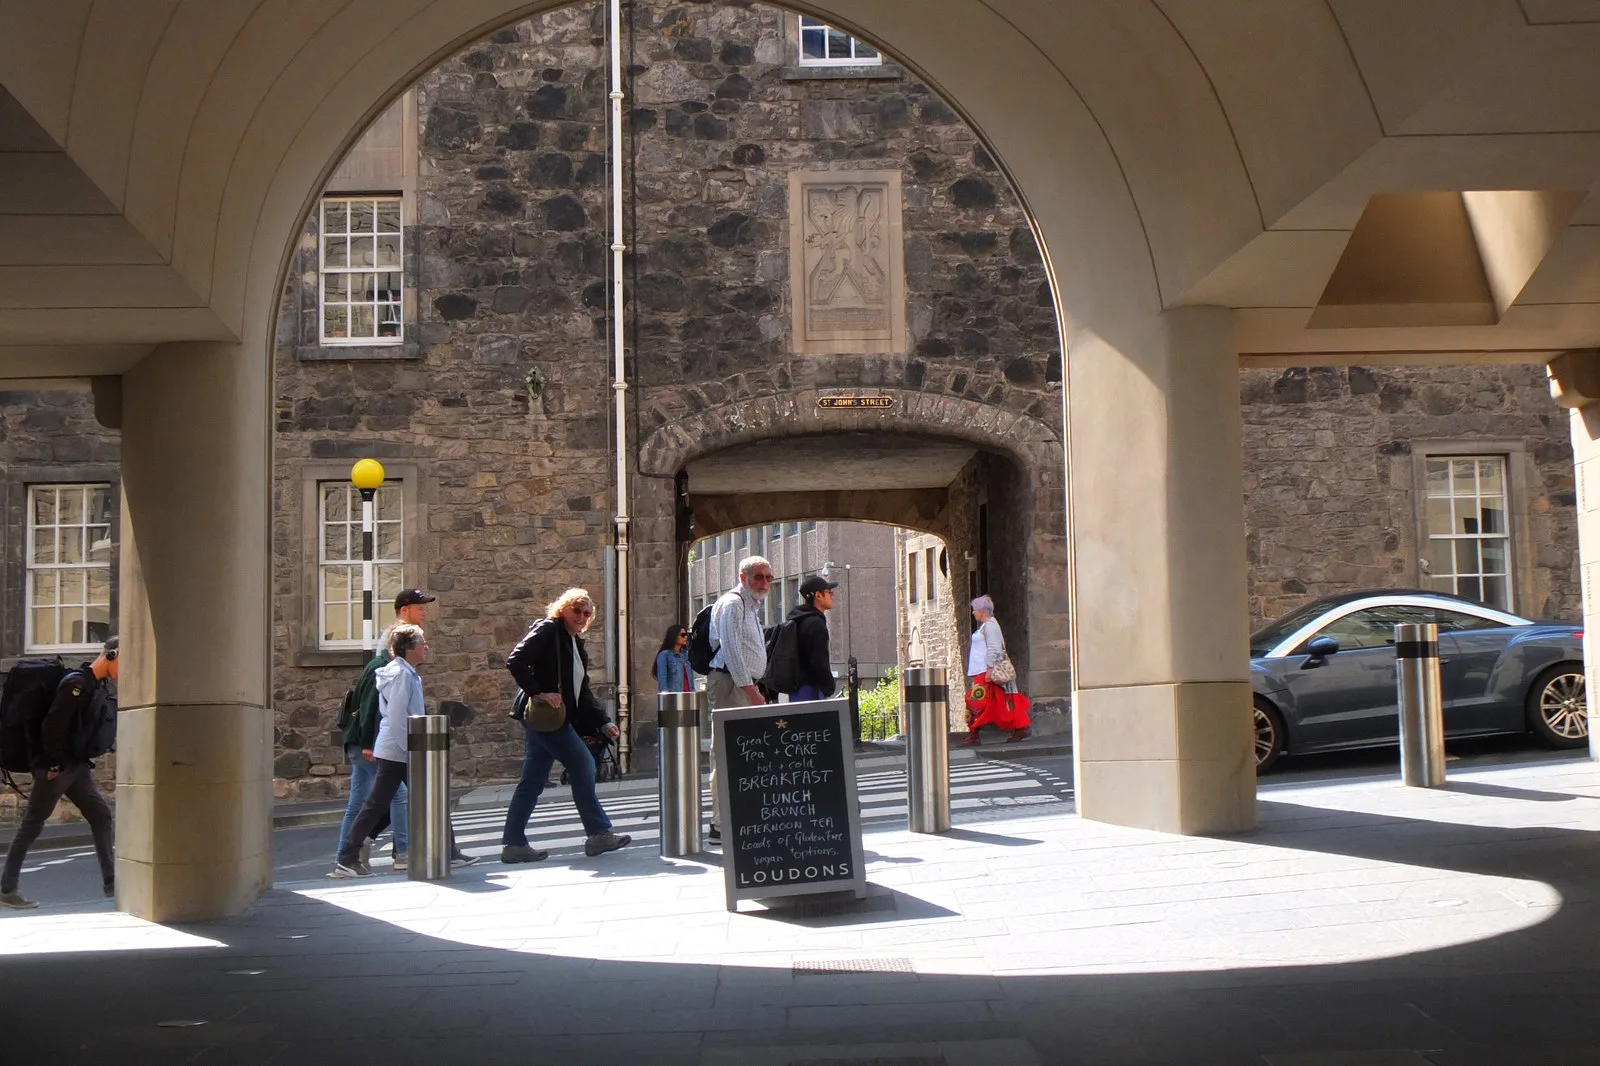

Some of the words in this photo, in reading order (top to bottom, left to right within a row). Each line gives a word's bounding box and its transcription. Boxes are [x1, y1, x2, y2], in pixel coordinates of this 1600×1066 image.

[737, 730, 773, 752] Great
[780, 729, 831, 745] COFFEE
[740, 750, 766, 762] Tea
[785, 743, 818, 757] CAKE
[757, 761, 773, 773] hot
[788, 757, 814, 770] cold
[739, 770, 834, 793] BREAKFAST
[763, 789, 812, 806] LUNCH
[760, 803, 816, 820] BRUNCH
[739, 821, 802, 836] AFTERNOON
[810, 817, 834, 828] TEA
[742, 837, 771, 850] Loads
[778, 834, 791, 847] of
[741, 863, 849, 884] LOUDONS
